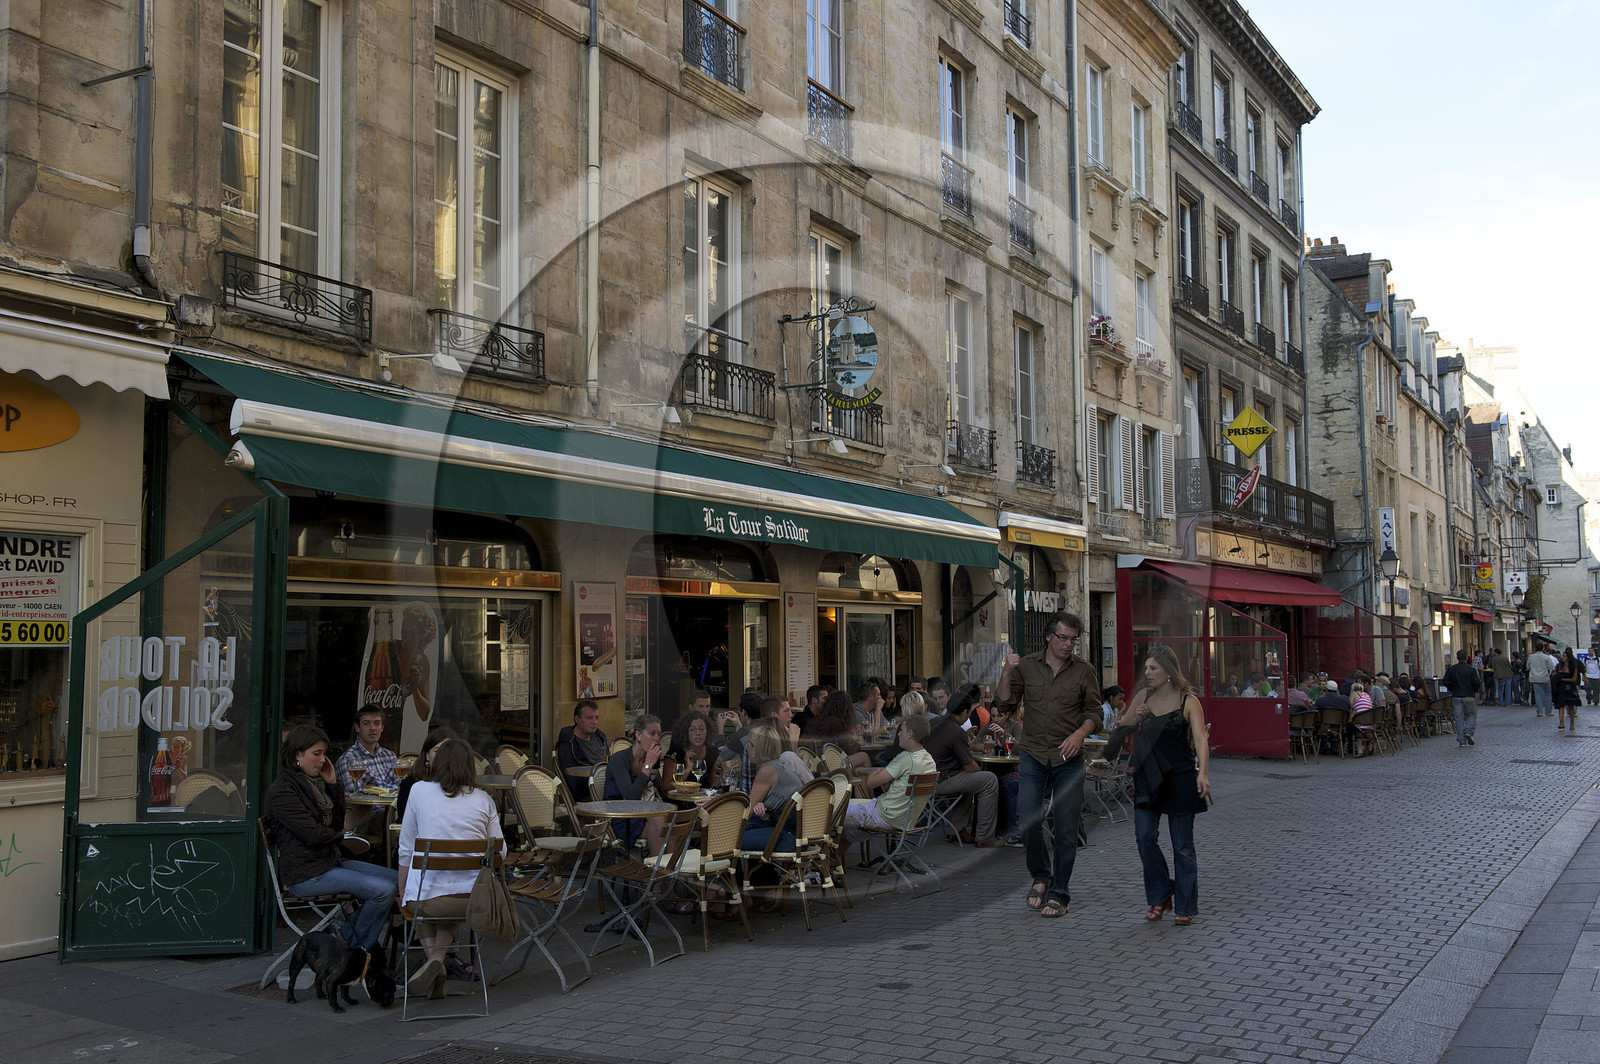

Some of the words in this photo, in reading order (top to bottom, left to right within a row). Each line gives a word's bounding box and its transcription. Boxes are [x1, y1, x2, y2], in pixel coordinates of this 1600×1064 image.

[1227, 426, 1269, 437] PRESSE
[1233, 469, 1257, 506] TABAC
[703, 507, 725, 534] La
[727, 511, 763, 537] Tour
[764, 515, 809, 543] Solidor
[1382, 513, 1392, 548] LAVE
[0, 536, 71, 558] NDRE
[15, 558, 64, 573] DAVID
[1, 580, 43, 588] prises
[23, 602, 42, 610] 14000
[1007, 589, 1032, 611] KY
[1031, 590, 1060, 613] WEST
[1, 623, 12, 641] 5
[18, 623, 40, 642] 60
[44, 623, 65, 642] 00
